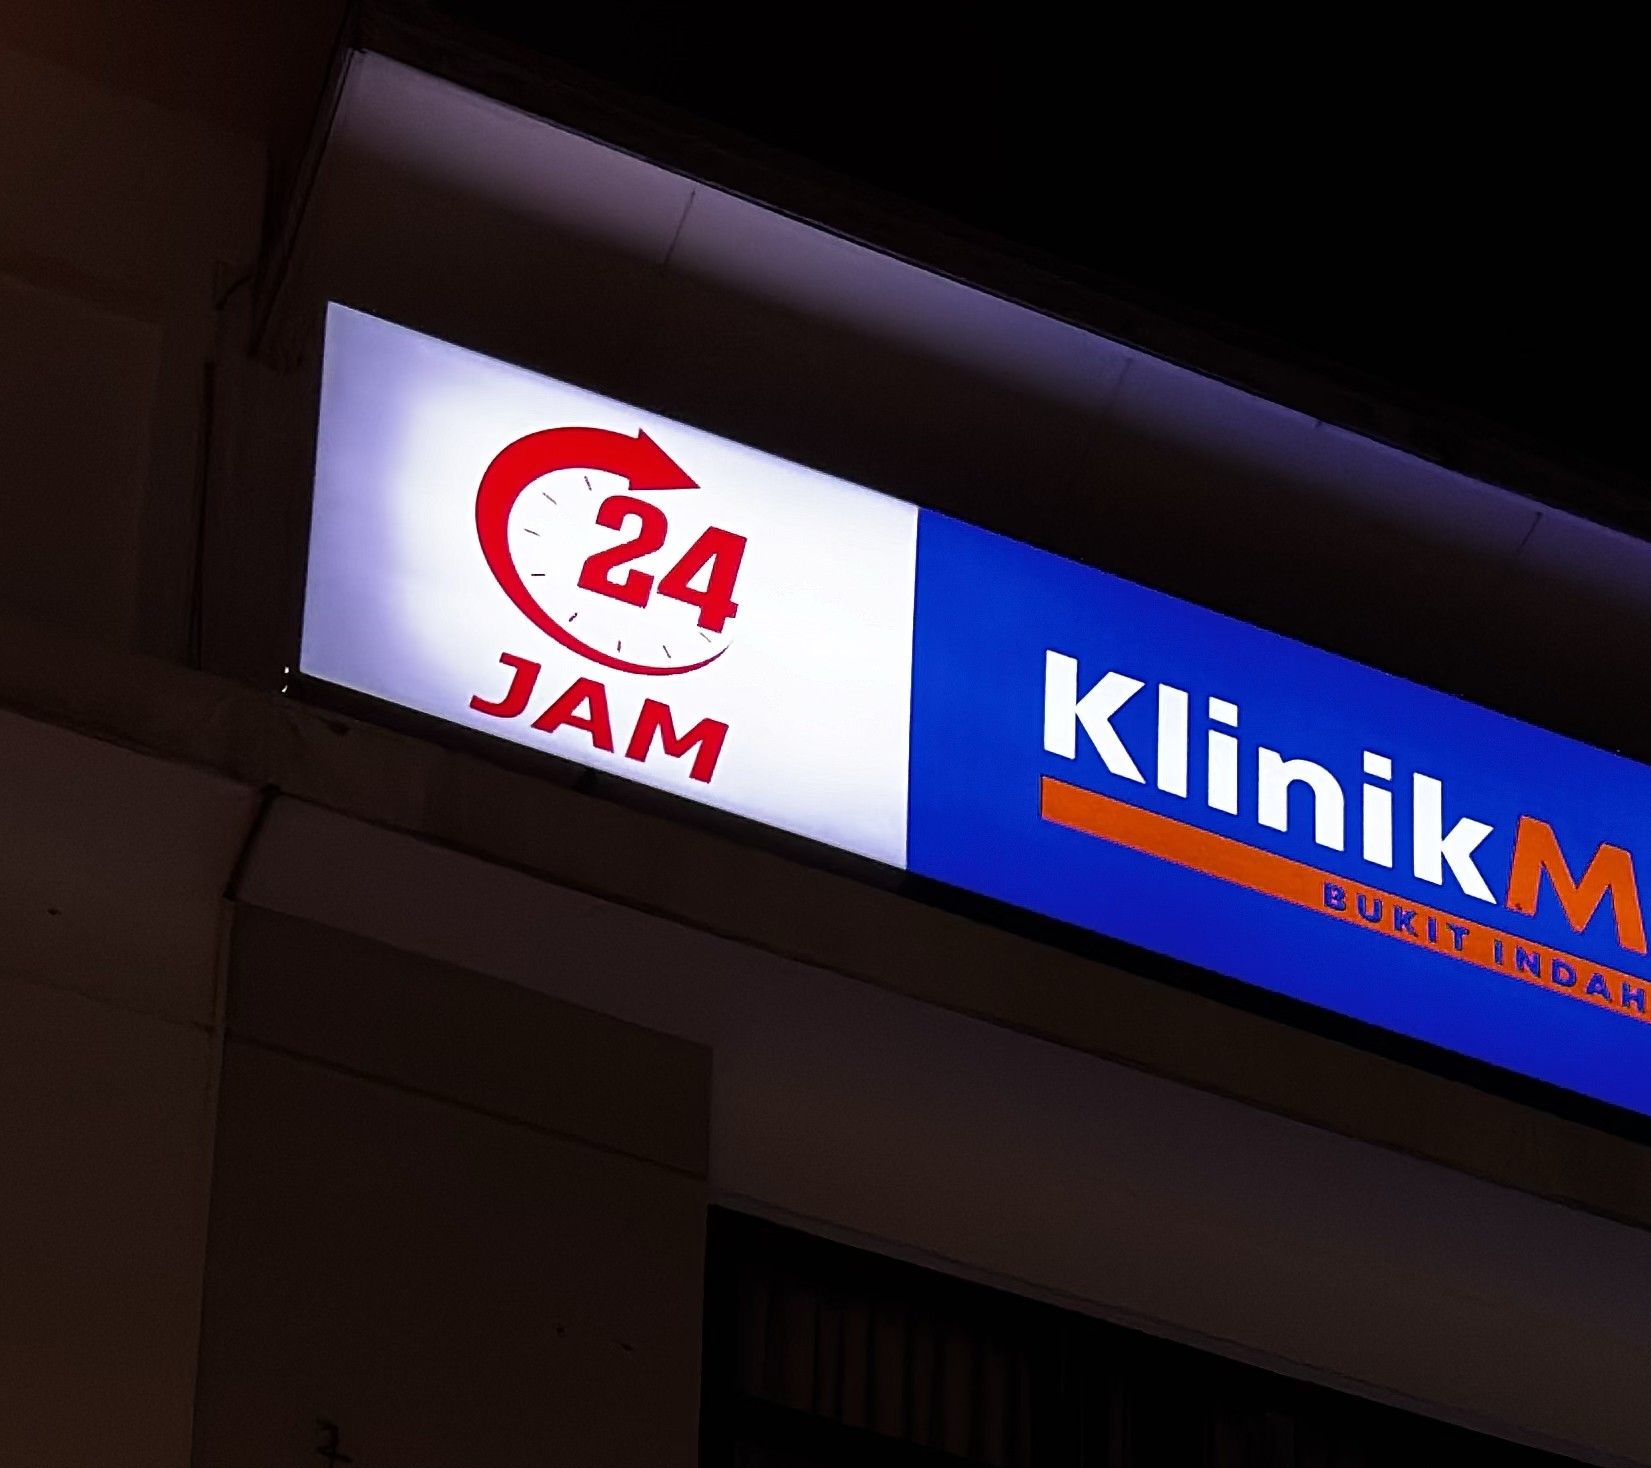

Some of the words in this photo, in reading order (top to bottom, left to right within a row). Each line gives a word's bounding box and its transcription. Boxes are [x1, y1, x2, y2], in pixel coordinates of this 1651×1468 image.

[576, 494, 748, 632] 24
[469, 652, 729, 785] JAM
[1322, 881, 1470, 954] BUKIT
